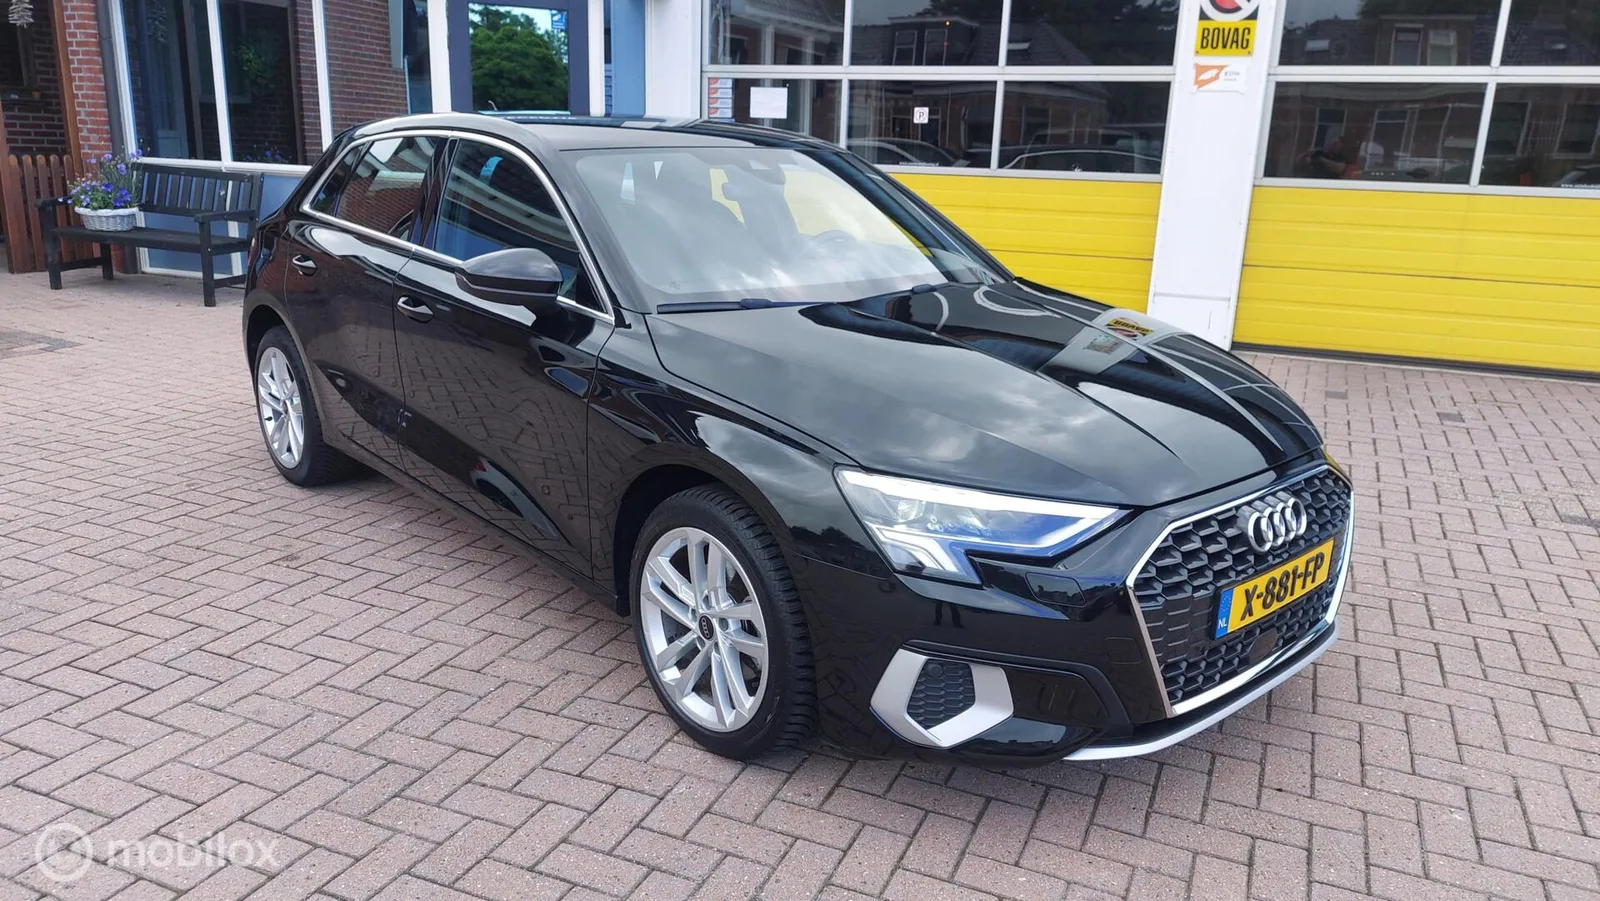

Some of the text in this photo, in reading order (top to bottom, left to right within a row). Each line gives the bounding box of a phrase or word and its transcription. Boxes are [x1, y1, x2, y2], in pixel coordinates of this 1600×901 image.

[1200, 27, 1251, 50] BOVAG
[1240, 552, 1325, 621] X-881-FP
[1218, 617, 1228, 629] NL
